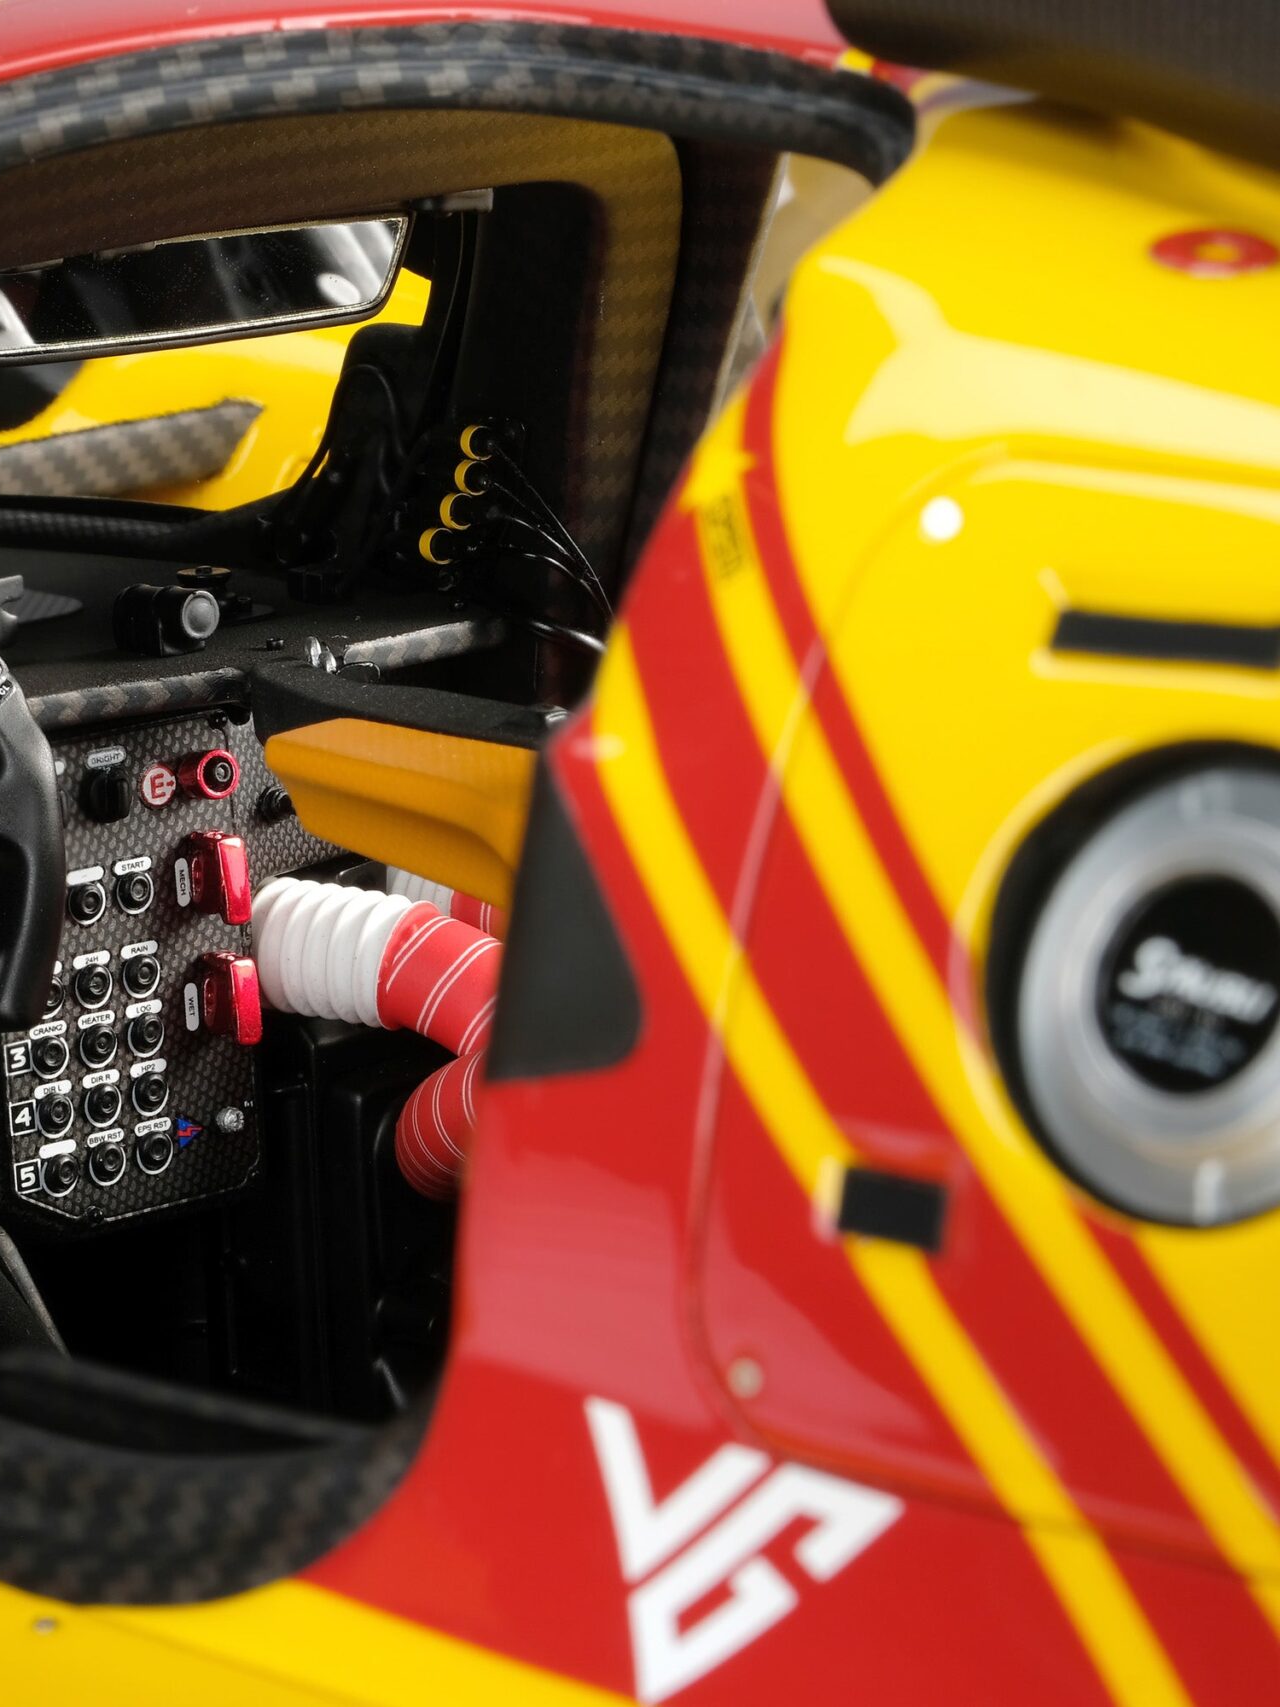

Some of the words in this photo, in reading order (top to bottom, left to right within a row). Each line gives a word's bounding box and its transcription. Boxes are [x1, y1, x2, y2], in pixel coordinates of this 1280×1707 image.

[121, 861, 145, 872] START
[179, 868, 187, 896] MECH
[130, 944, 149, 955] RAIN
[135, 1003, 152, 1014] LOG
[187, 996, 196, 1017] WET
[81, 1013, 111, 1026] HEATER
[32, 1023, 64, 1037] CRANK2
[9, 1046, 27, 1070] 3
[140, 1063, 156, 1073] HP2
[90, 1075, 104, 1084] DIR
[43, 1086, 57, 1096] DIR
[14, 1106, 33, 1128] 4
[137, 1123, 153, 1133] EPS
[153, 1120, 169, 1130] RST
[88, 1133, 108, 1145] BBW
[107, 1131, 122, 1141] RST
[19, 1165, 36, 1189] 5
